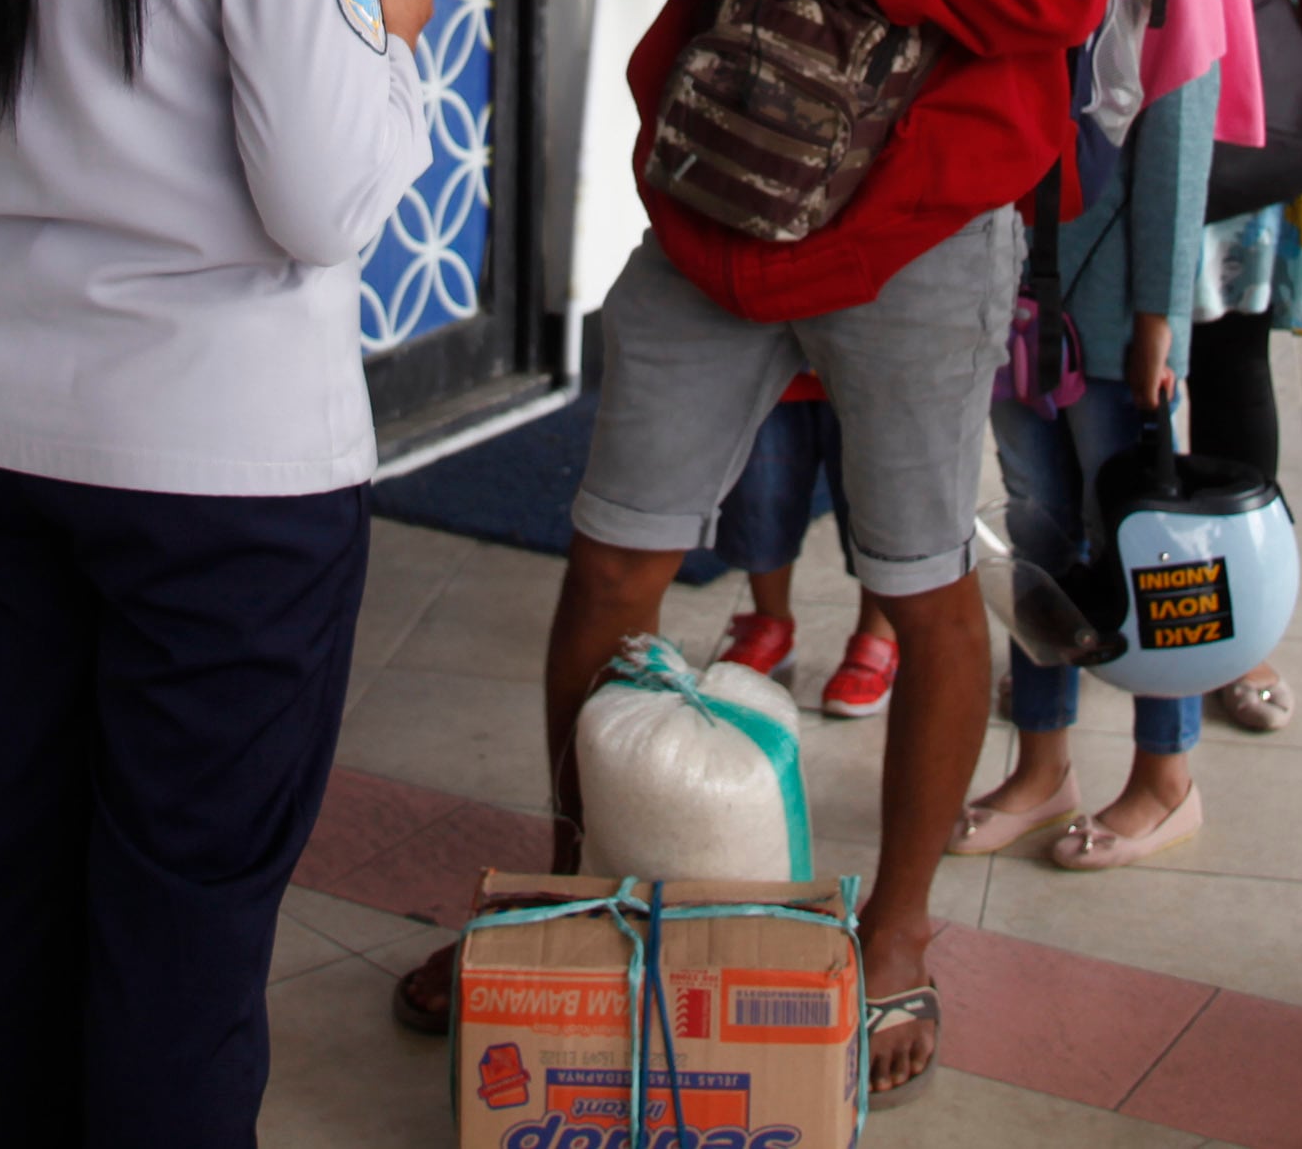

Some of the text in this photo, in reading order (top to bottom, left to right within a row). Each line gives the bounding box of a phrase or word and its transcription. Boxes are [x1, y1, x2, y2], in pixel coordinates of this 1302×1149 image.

[1138, 562, 1222, 592] ANDINI
[1149, 592, 1220, 621] NOVI
[1154, 620, 1223, 648] ZAKI
[469, 985, 631, 1017] BAWANG AM
[698, 1074, 740, 1087] JELAS
[571, 1097, 667, 1121] Intant
